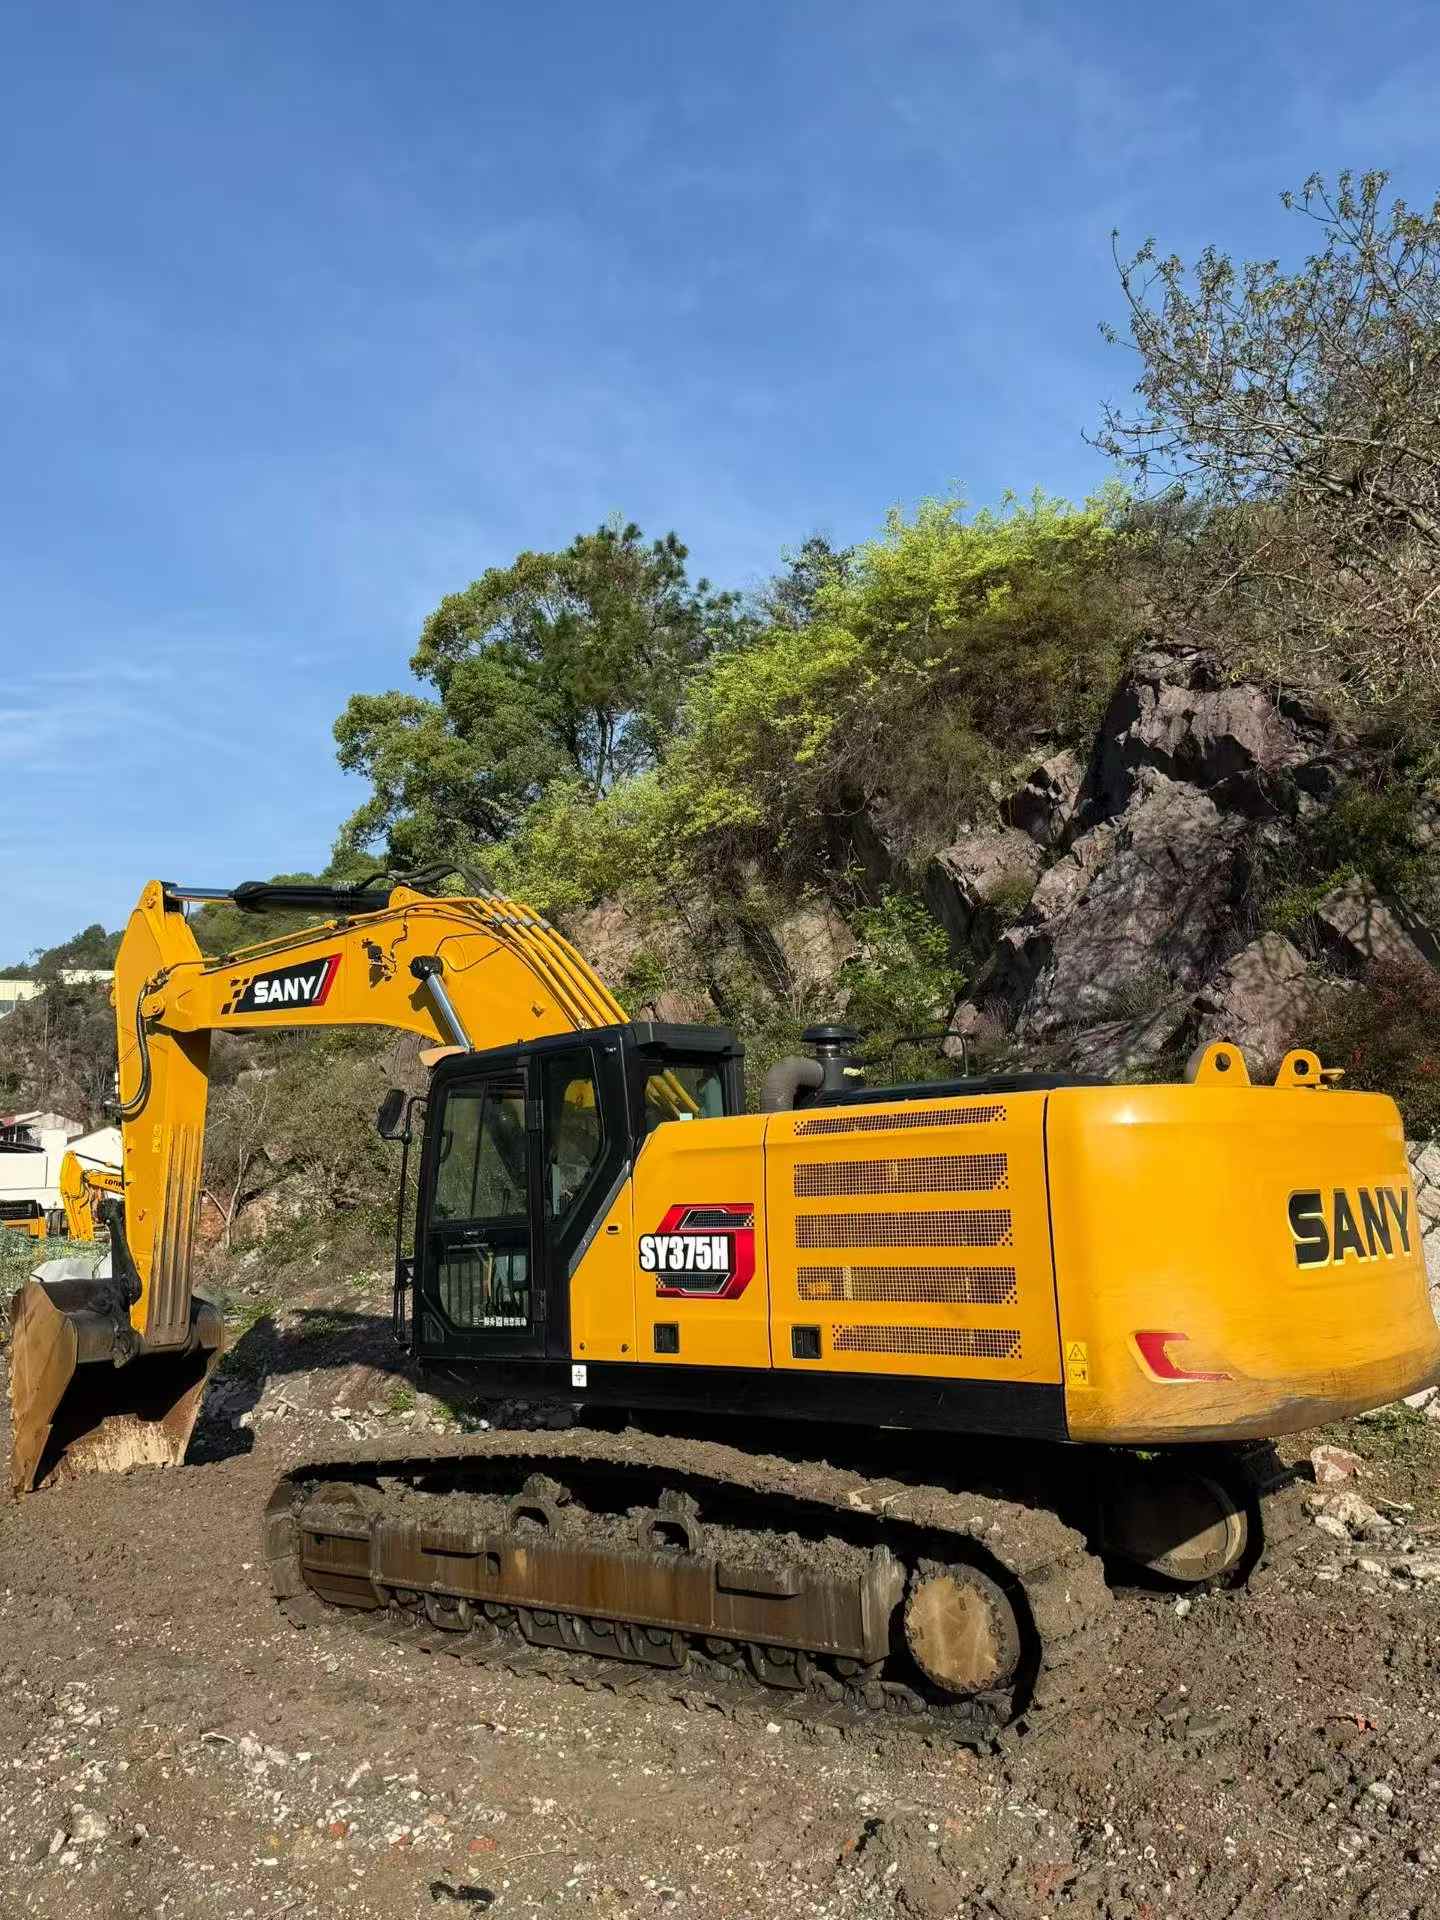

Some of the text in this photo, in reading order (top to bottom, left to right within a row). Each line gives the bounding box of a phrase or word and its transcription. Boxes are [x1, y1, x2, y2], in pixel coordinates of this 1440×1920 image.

[253, 975, 317, 1004] SANY
[1287, 1187, 1411, 1270] SANY
[639, 1235, 729, 1271] SY375H
